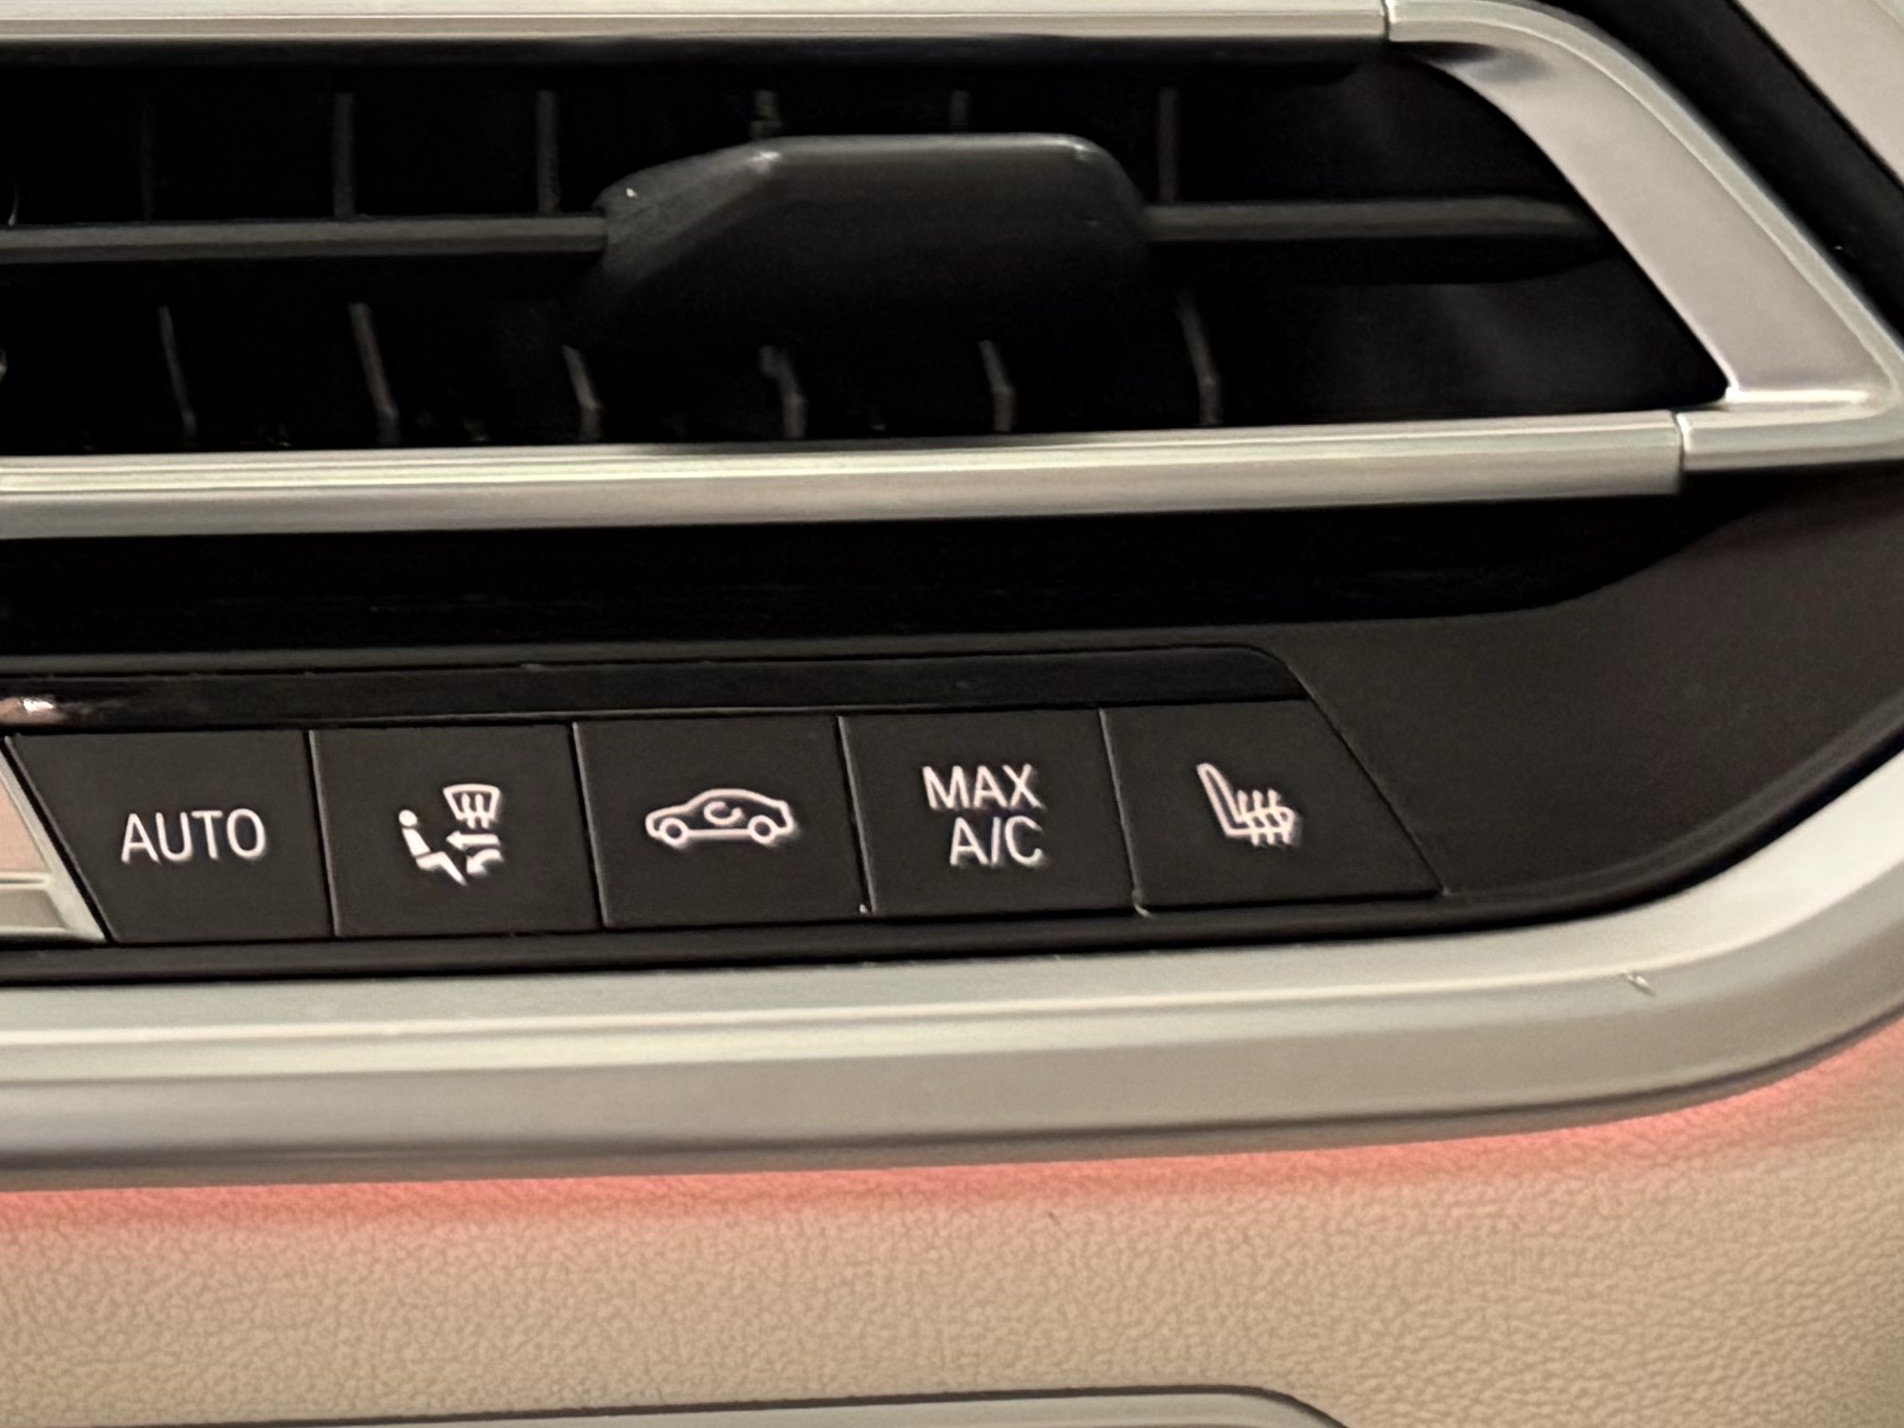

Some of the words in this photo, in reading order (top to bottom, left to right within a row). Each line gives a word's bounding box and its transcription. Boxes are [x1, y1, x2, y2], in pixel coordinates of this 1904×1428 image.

[923, 764, 1041, 809] MAX
[122, 809, 265, 862] AUTO
[950, 816, 1042, 865] A/C
